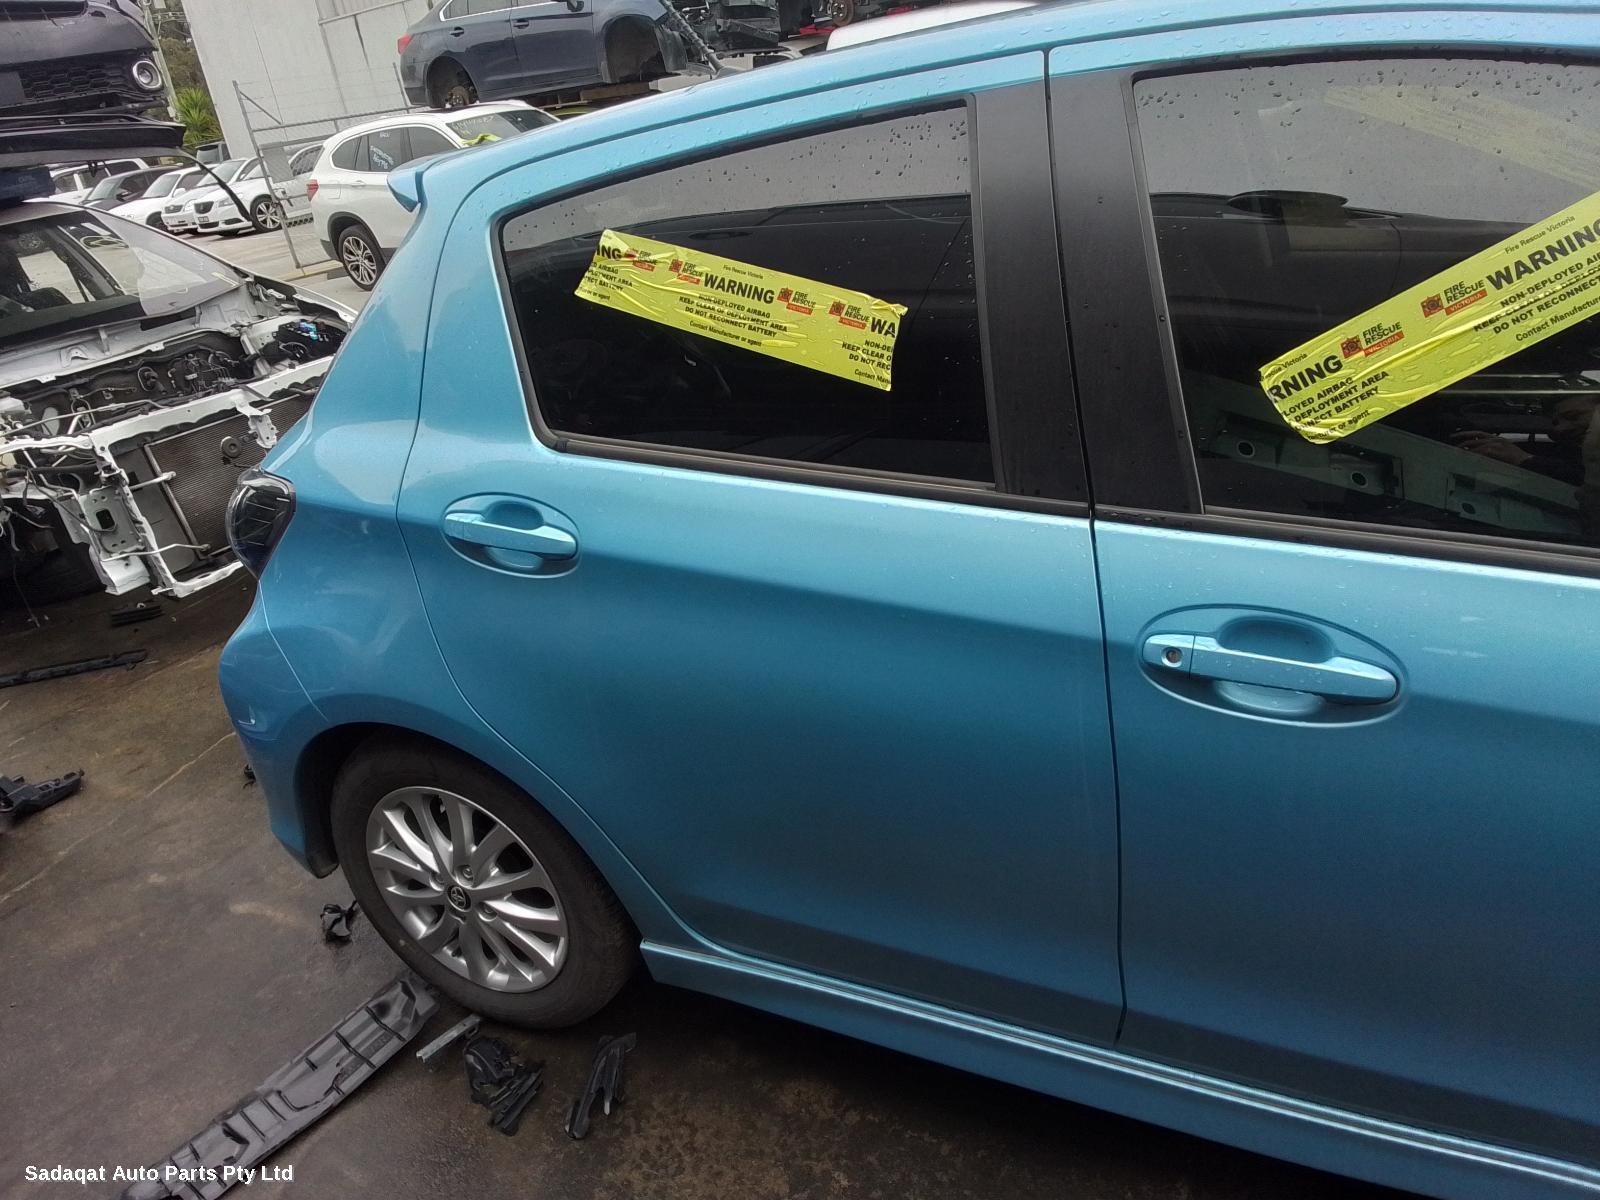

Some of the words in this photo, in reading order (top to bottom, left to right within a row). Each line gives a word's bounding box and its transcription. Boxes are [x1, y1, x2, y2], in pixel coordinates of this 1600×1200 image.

[1504, 244, 1520, 255] Fire
[1520, 230, 1547, 247] Rescue
[1546, 215, 1576, 233] Victoria
[704, 272, 775, 305] WARNING
[1443, 281, 1465, 296] FIRE
[1446, 280, 1485, 304] RESCUE
[1500, 262, 1583, 308] NON-DEPLOYED
[792, 297, 817, 309] RESCUE
[794, 291, 809, 300] FIRE
[1450, 292, 1483, 311] VICTORIA
[679, 296, 695, 305] KEEP
[769, 322, 788, 332] AREA
[746, 307, 771, 319] AIRBAG
[844, 311, 871, 323] RESCUE
[847, 305, 862, 313] FIRE
[685, 306, 695, 314] DO
[695, 309, 708, 318] NOT
[709, 314, 747, 329] RECONNECT
[748, 325, 778, 338] BATTERY
[871, 317, 896, 338] WA
[1362, 323, 1383, 338] FIRE
[1493, 322, 1510, 334] DO
[1511, 308, 1534, 325] NOT
[690, 321, 708, 331] Contact
[708, 326, 741, 341] Manufacturer
[1365, 322, 1402, 345] RESCUE
[1515, 322, 1550, 342] Contact
[842, 341, 861, 352] KEEP
[861, 348, 884, 360] CLEAR
[865, 340, 893, 353] NON-DE
[1367, 334, 1400, 353] VICTORIA
[849, 353, 860, 361] DO
[860, 358, 876, 366] NOT
[876, 361, 891, 370] REC
[1281, 353, 1307, 368] Victoria
[854, 369, 876, 379] Contact
[1294, 385, 1358, 422] DEPLOYMENT
[1361, 371, 1389, 389] AREA
[1334, 386, 1378, 414] BATTERY
[1283, 397, 1314, 417] LOYED
[1347, 409, 1370, 424] agent
